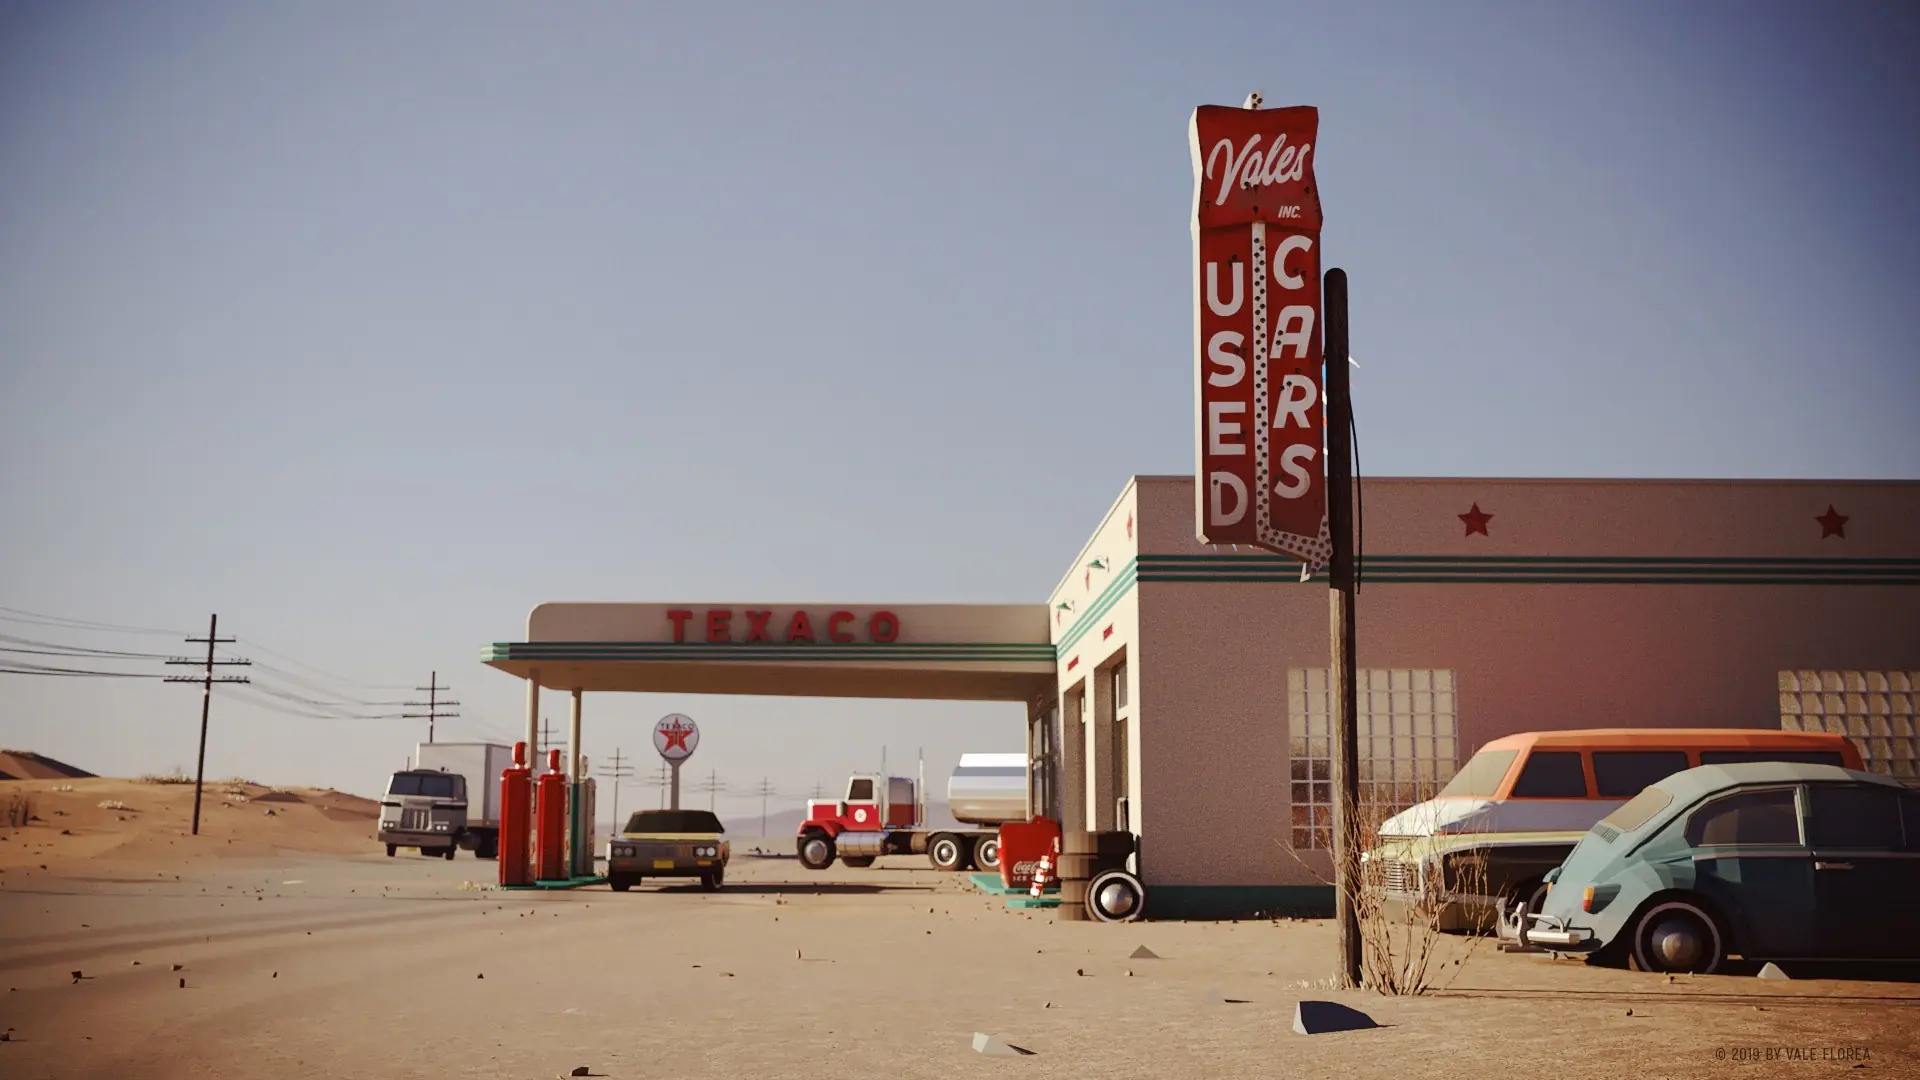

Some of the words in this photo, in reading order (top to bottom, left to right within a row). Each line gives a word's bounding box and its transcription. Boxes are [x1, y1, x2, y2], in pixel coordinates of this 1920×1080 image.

[1206, 133, 1311, 206] Vales
[1278, 205, 1302, 219] INC.
[1206, 261, 1249, 527] USED
[1269, 234, 1318, 500] CARS
[666, 609, 900, 643] TEXACO
